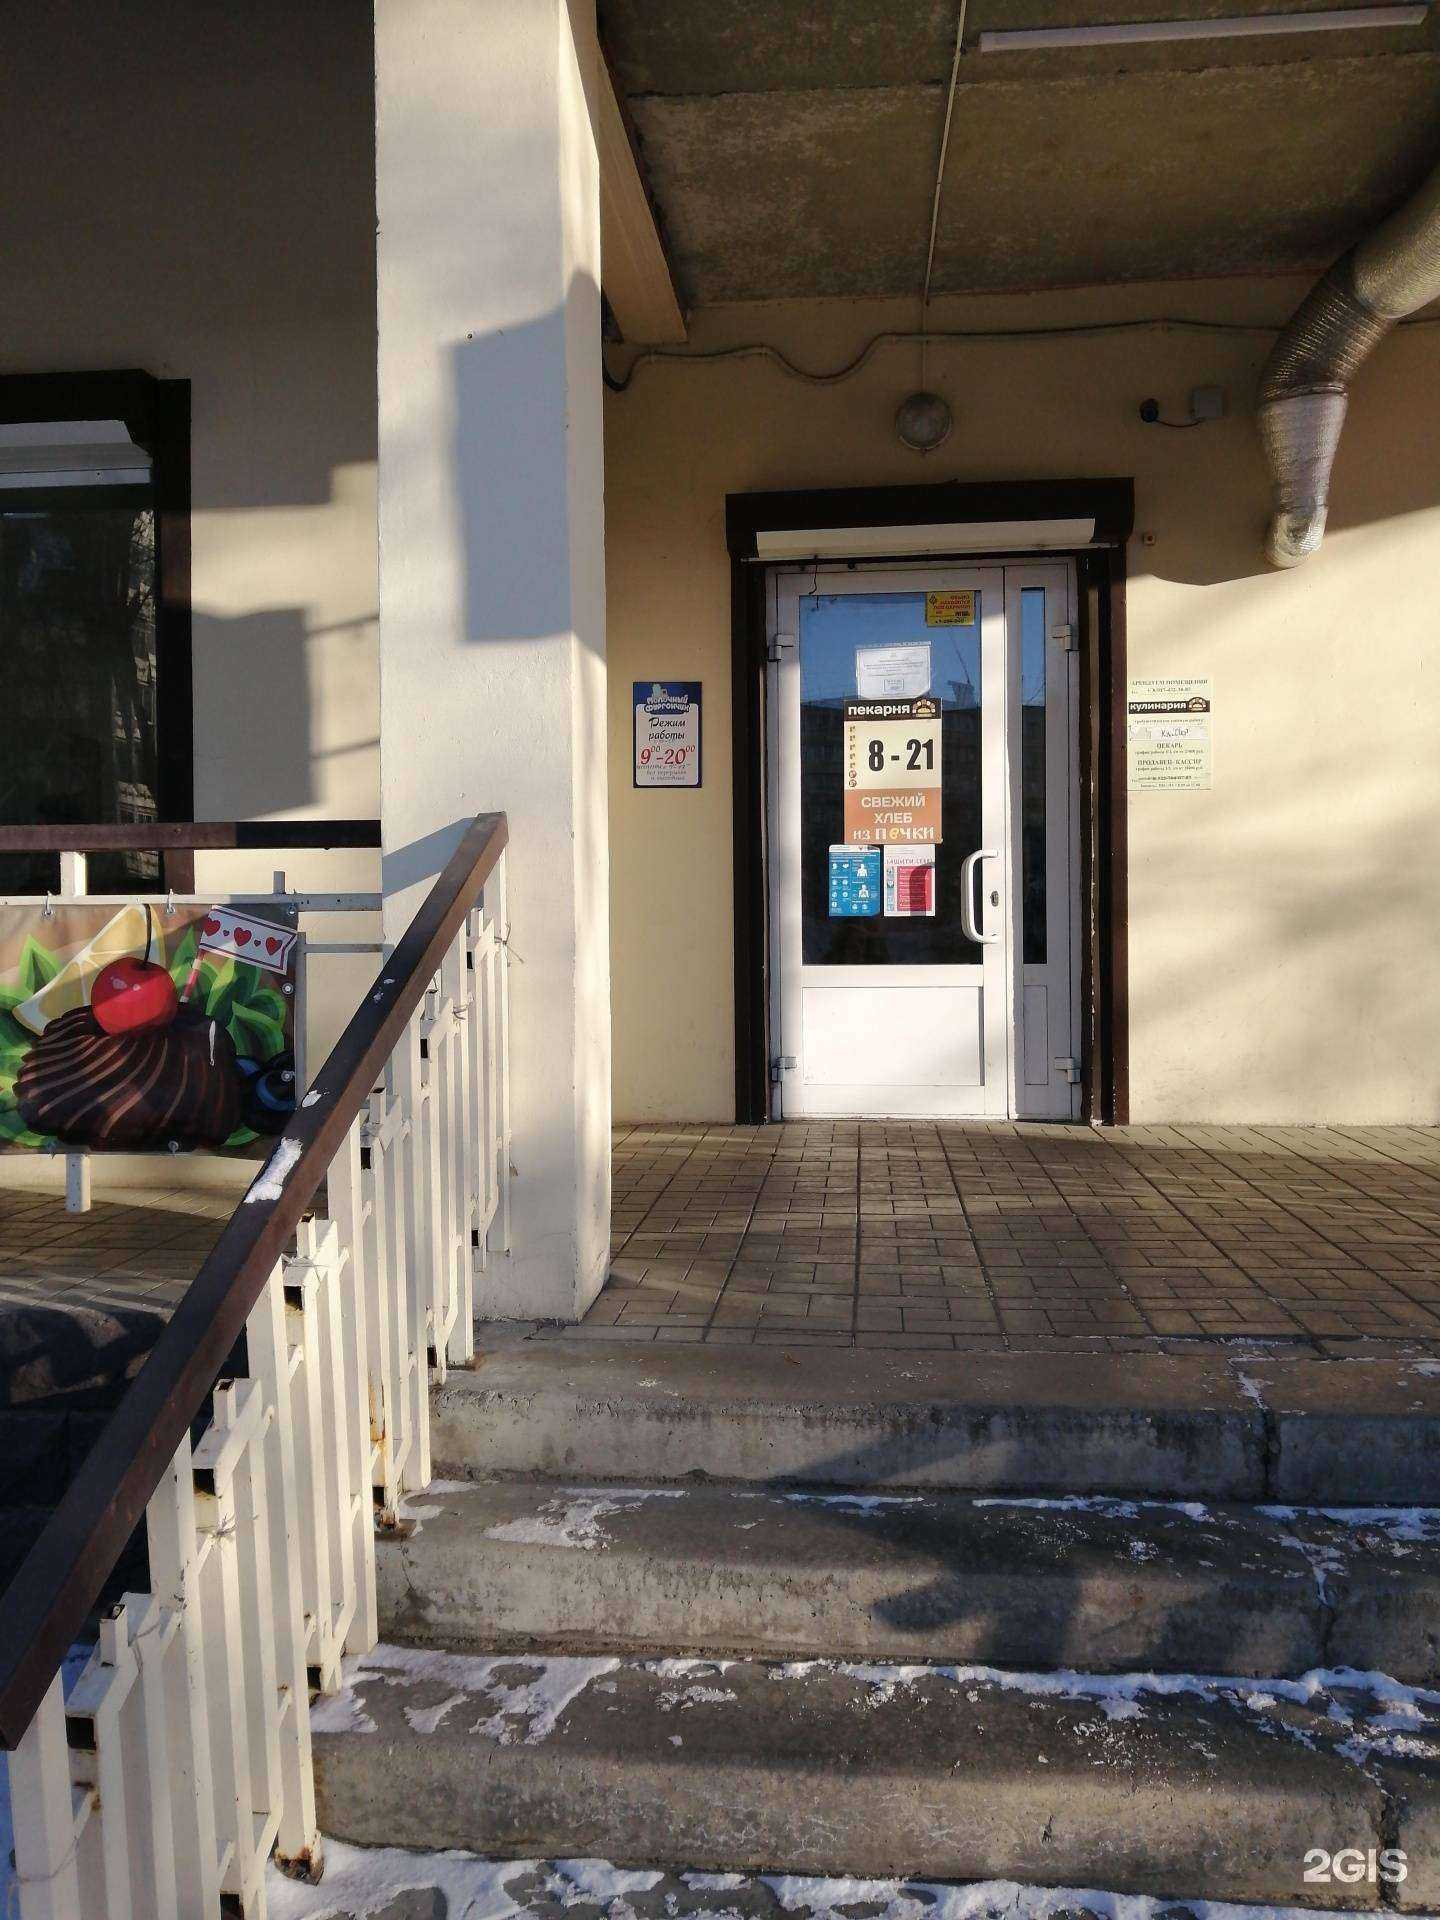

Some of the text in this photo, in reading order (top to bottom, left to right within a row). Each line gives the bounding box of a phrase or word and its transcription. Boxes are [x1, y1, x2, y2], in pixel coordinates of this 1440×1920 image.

[847, 703, 911, 717] пекарня
[1129, 702, 1187, 712] кулинария
[648, 717, 686, 728] Режим
[648, 729, 685, 741] работы
[868, 740, 885, 772] 8
[906, 738, 934, 771] 21
[861, 792, 926, 808] СВЕЖИЙ
[874, 812, 913, 824] ХЛЕБ
